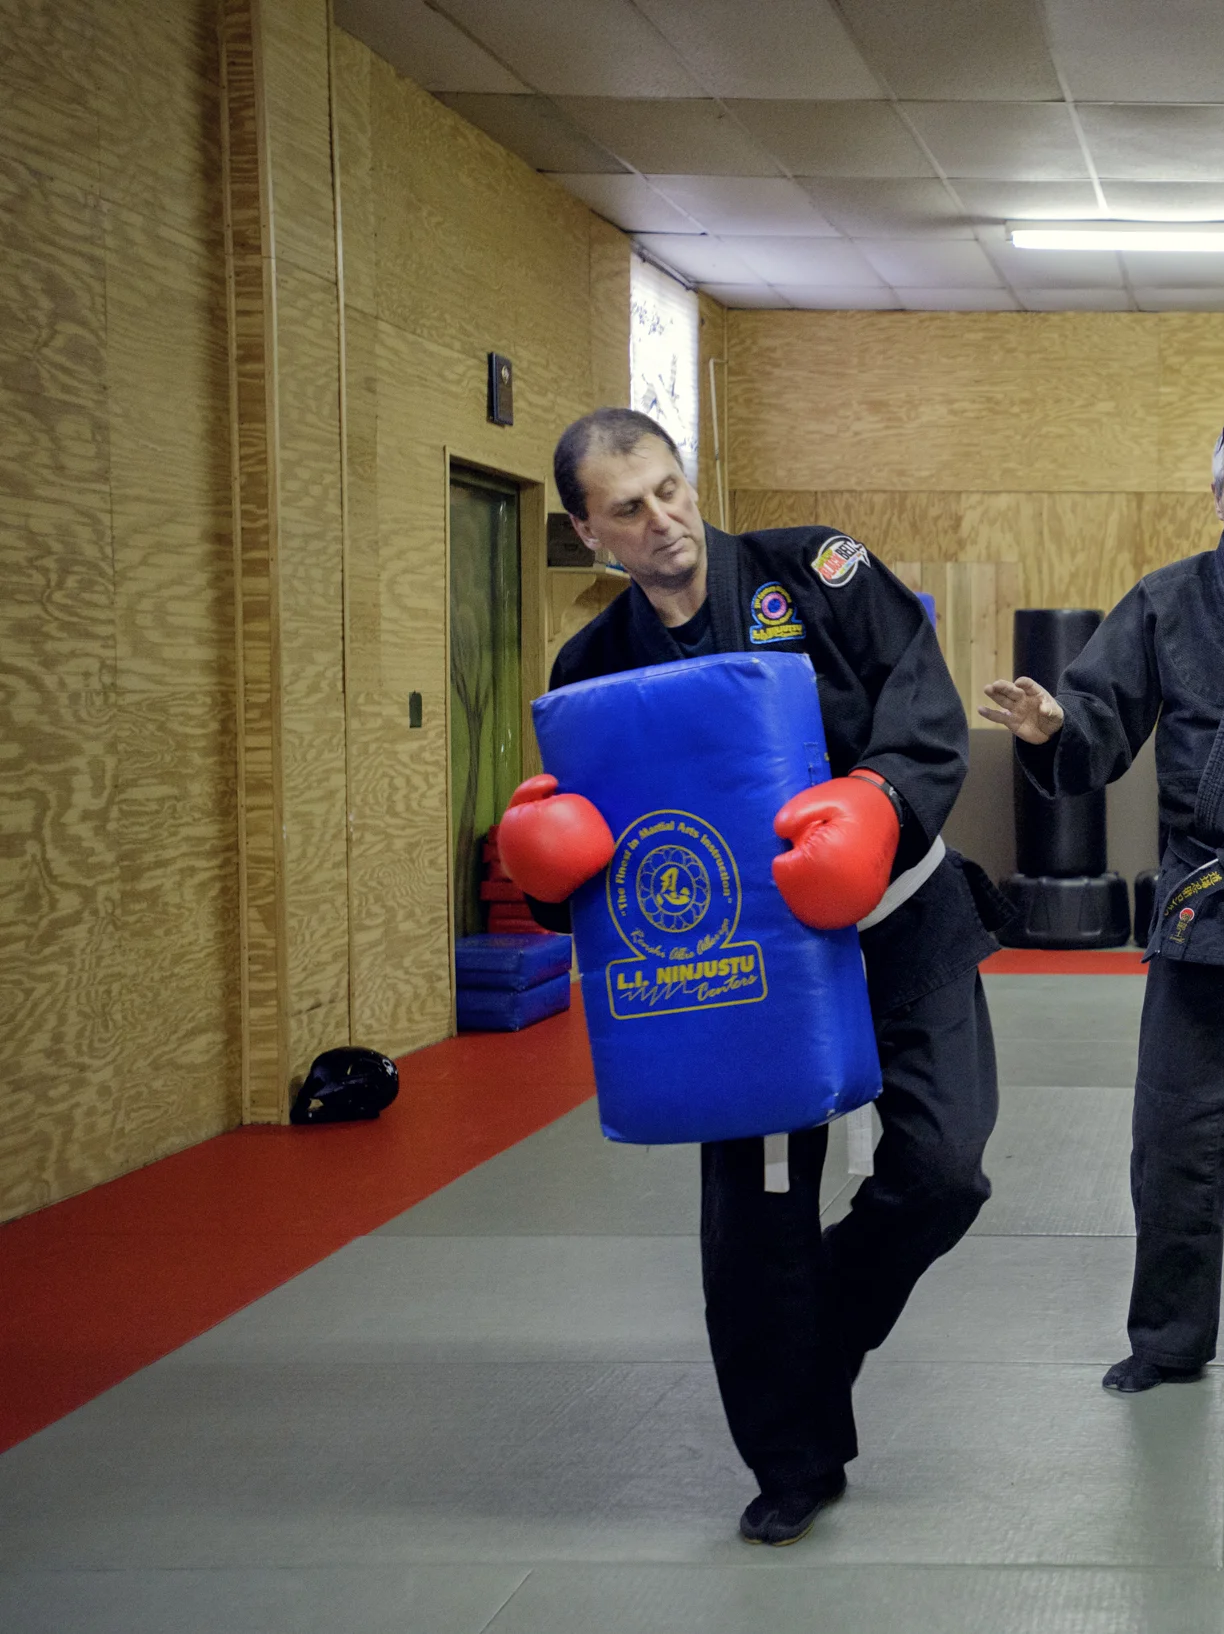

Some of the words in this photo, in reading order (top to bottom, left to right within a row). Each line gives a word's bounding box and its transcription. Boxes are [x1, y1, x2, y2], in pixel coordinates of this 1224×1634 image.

[818, 552, 847, 580] BLACK
[835, 540, 857, 560] BELT
[615, 849, 632, 884] Finest
[627, 839, 640, 850] in
[639, 821, 674, 838] Martial
[677, 822, 699, 838] Arts
[617, 970, 650, 990] L.I.
[656, 954, 755, 984] NINJUSTU
[697, 974, 759, 1002] Centers
